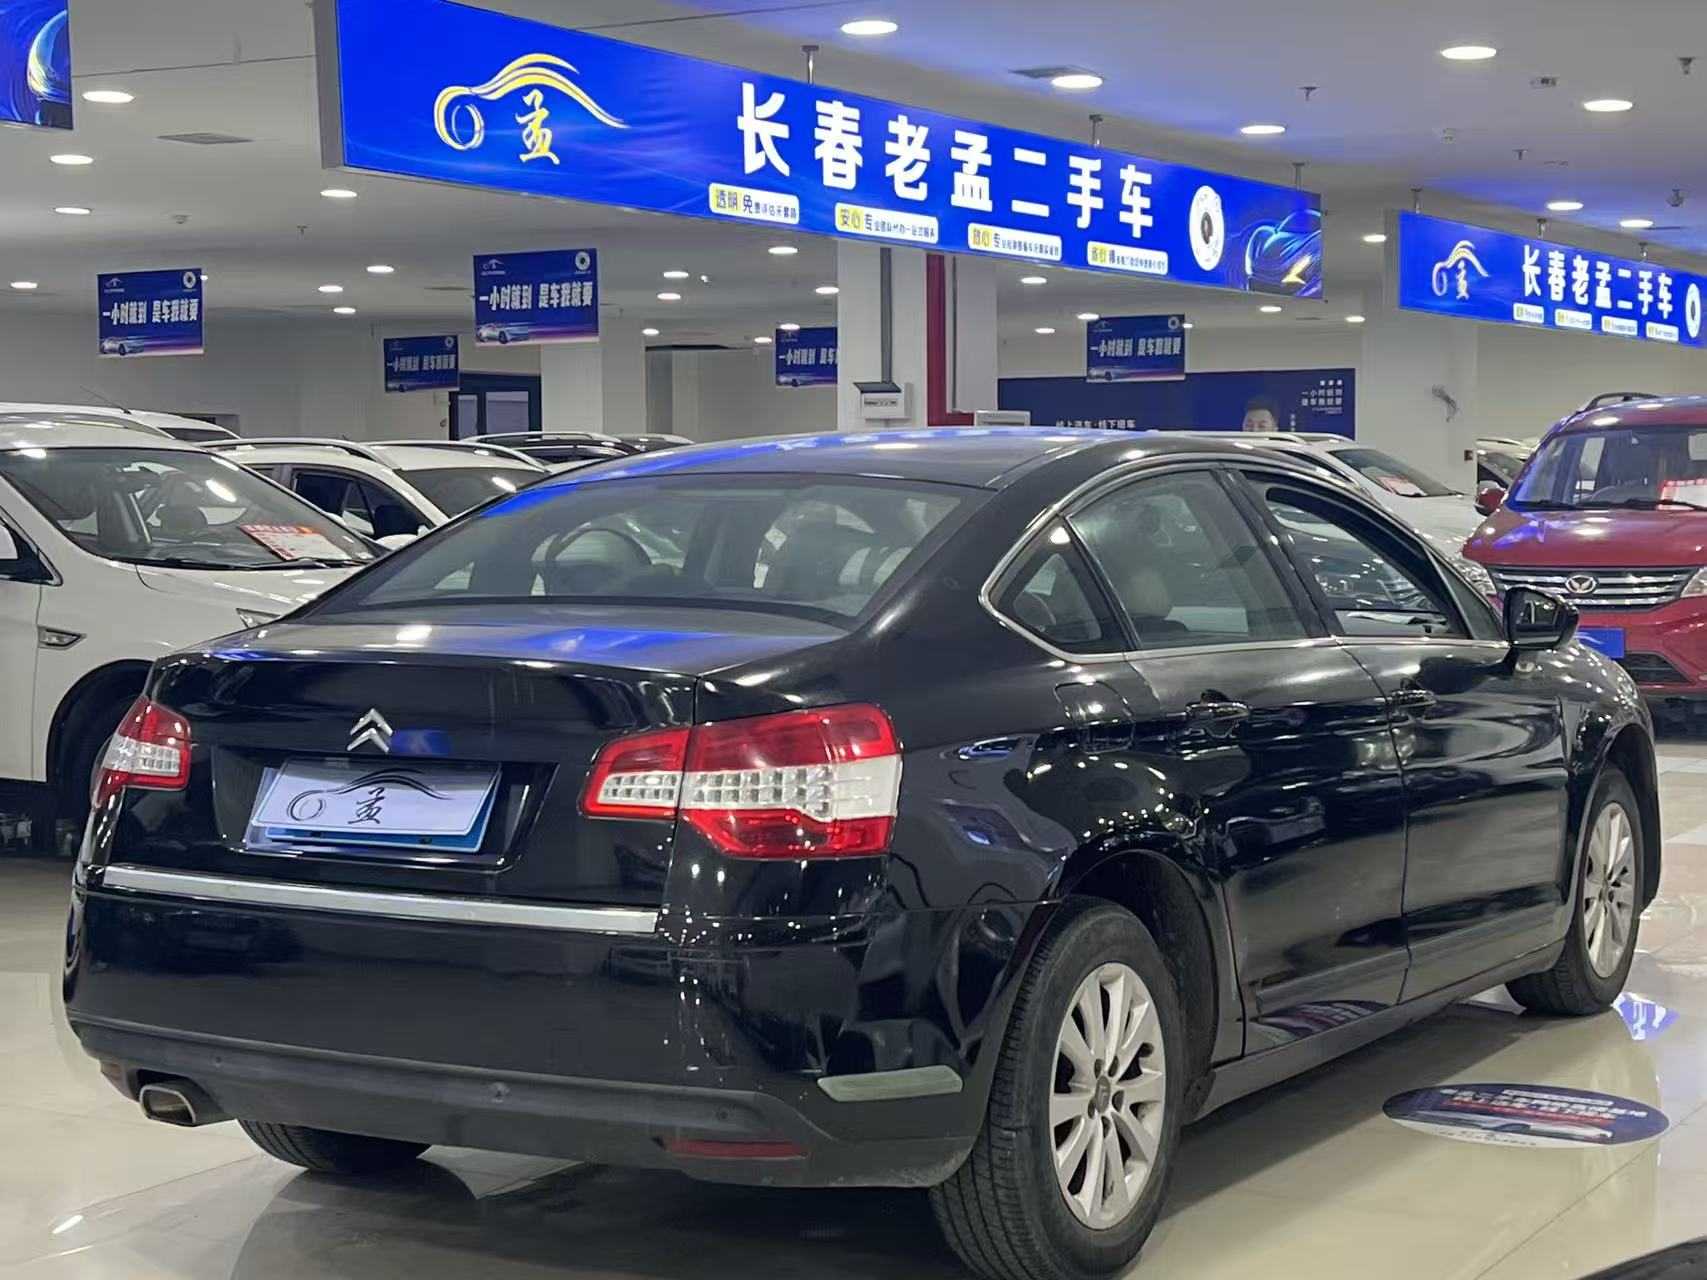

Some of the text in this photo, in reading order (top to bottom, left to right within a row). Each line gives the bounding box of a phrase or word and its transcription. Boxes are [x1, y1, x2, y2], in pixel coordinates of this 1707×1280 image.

[737, 82, 1153, 239] 长春老孟二手车
[1522, 244, 1673, 320] 长春老孟二手车
